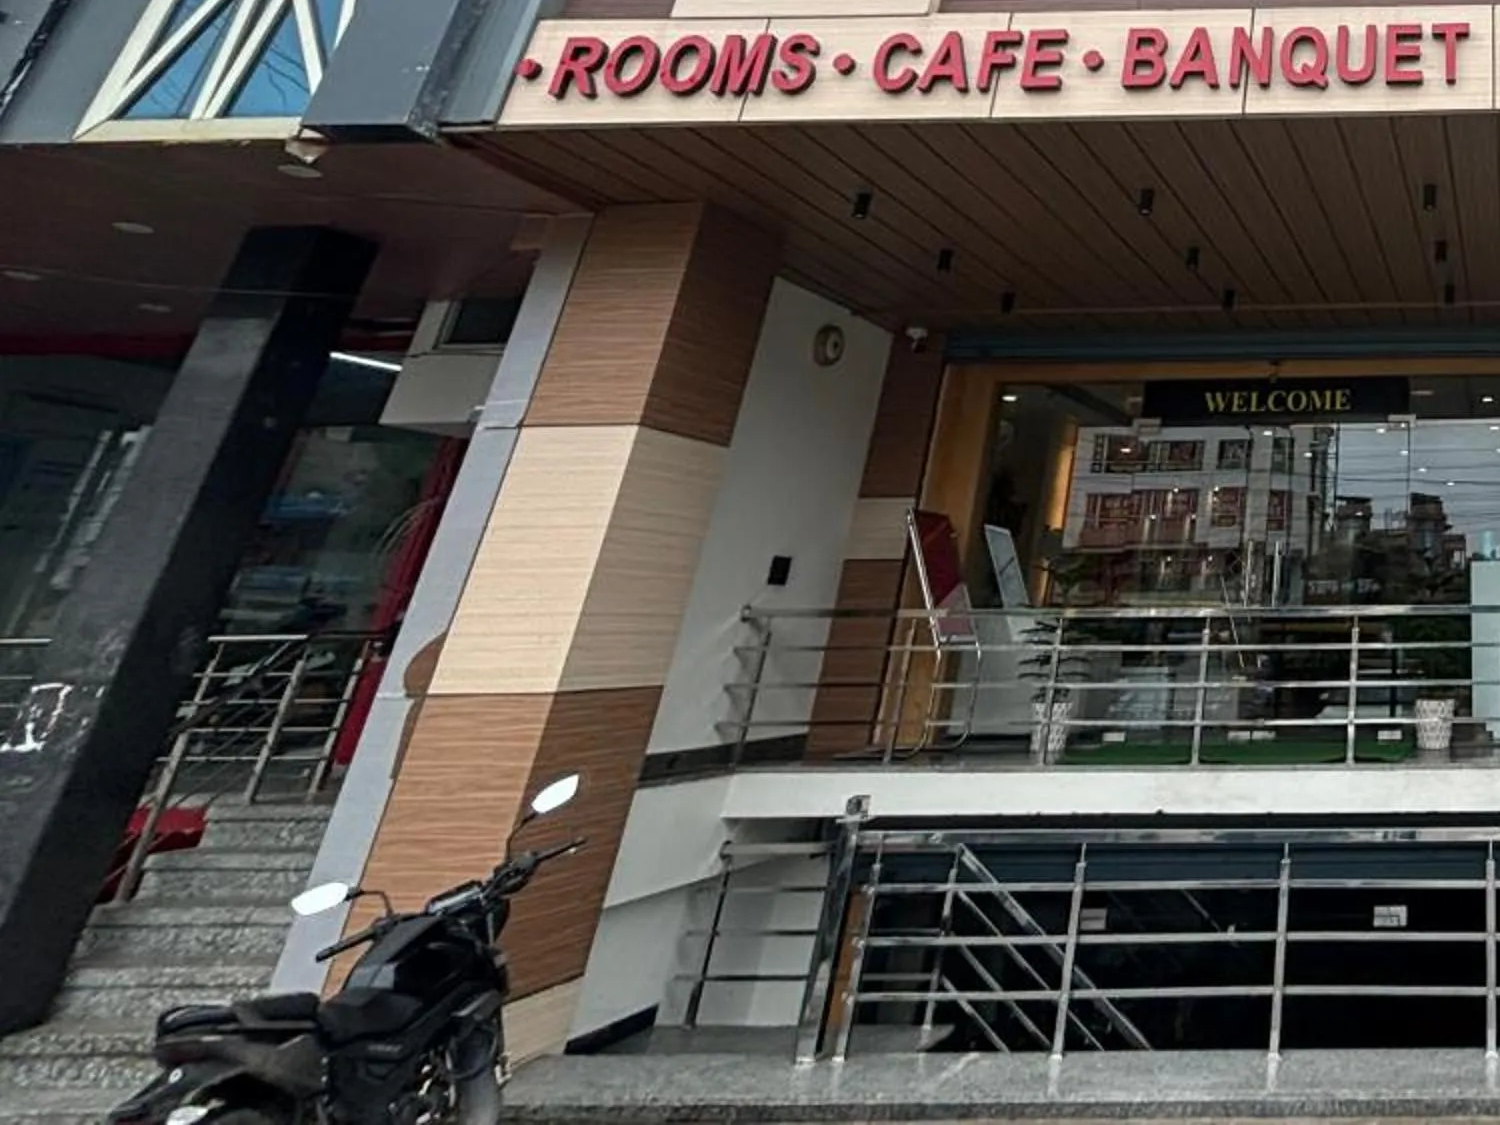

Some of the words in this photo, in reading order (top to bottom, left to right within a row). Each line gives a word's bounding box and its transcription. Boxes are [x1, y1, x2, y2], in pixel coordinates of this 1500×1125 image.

[548, 33, 820, 98] ROOMS
[873, 28, 1069, 94] CAFE
[1121, 22, 1470, 90] BANQUET
[1204, 389, 1351, 412] WELCOME
